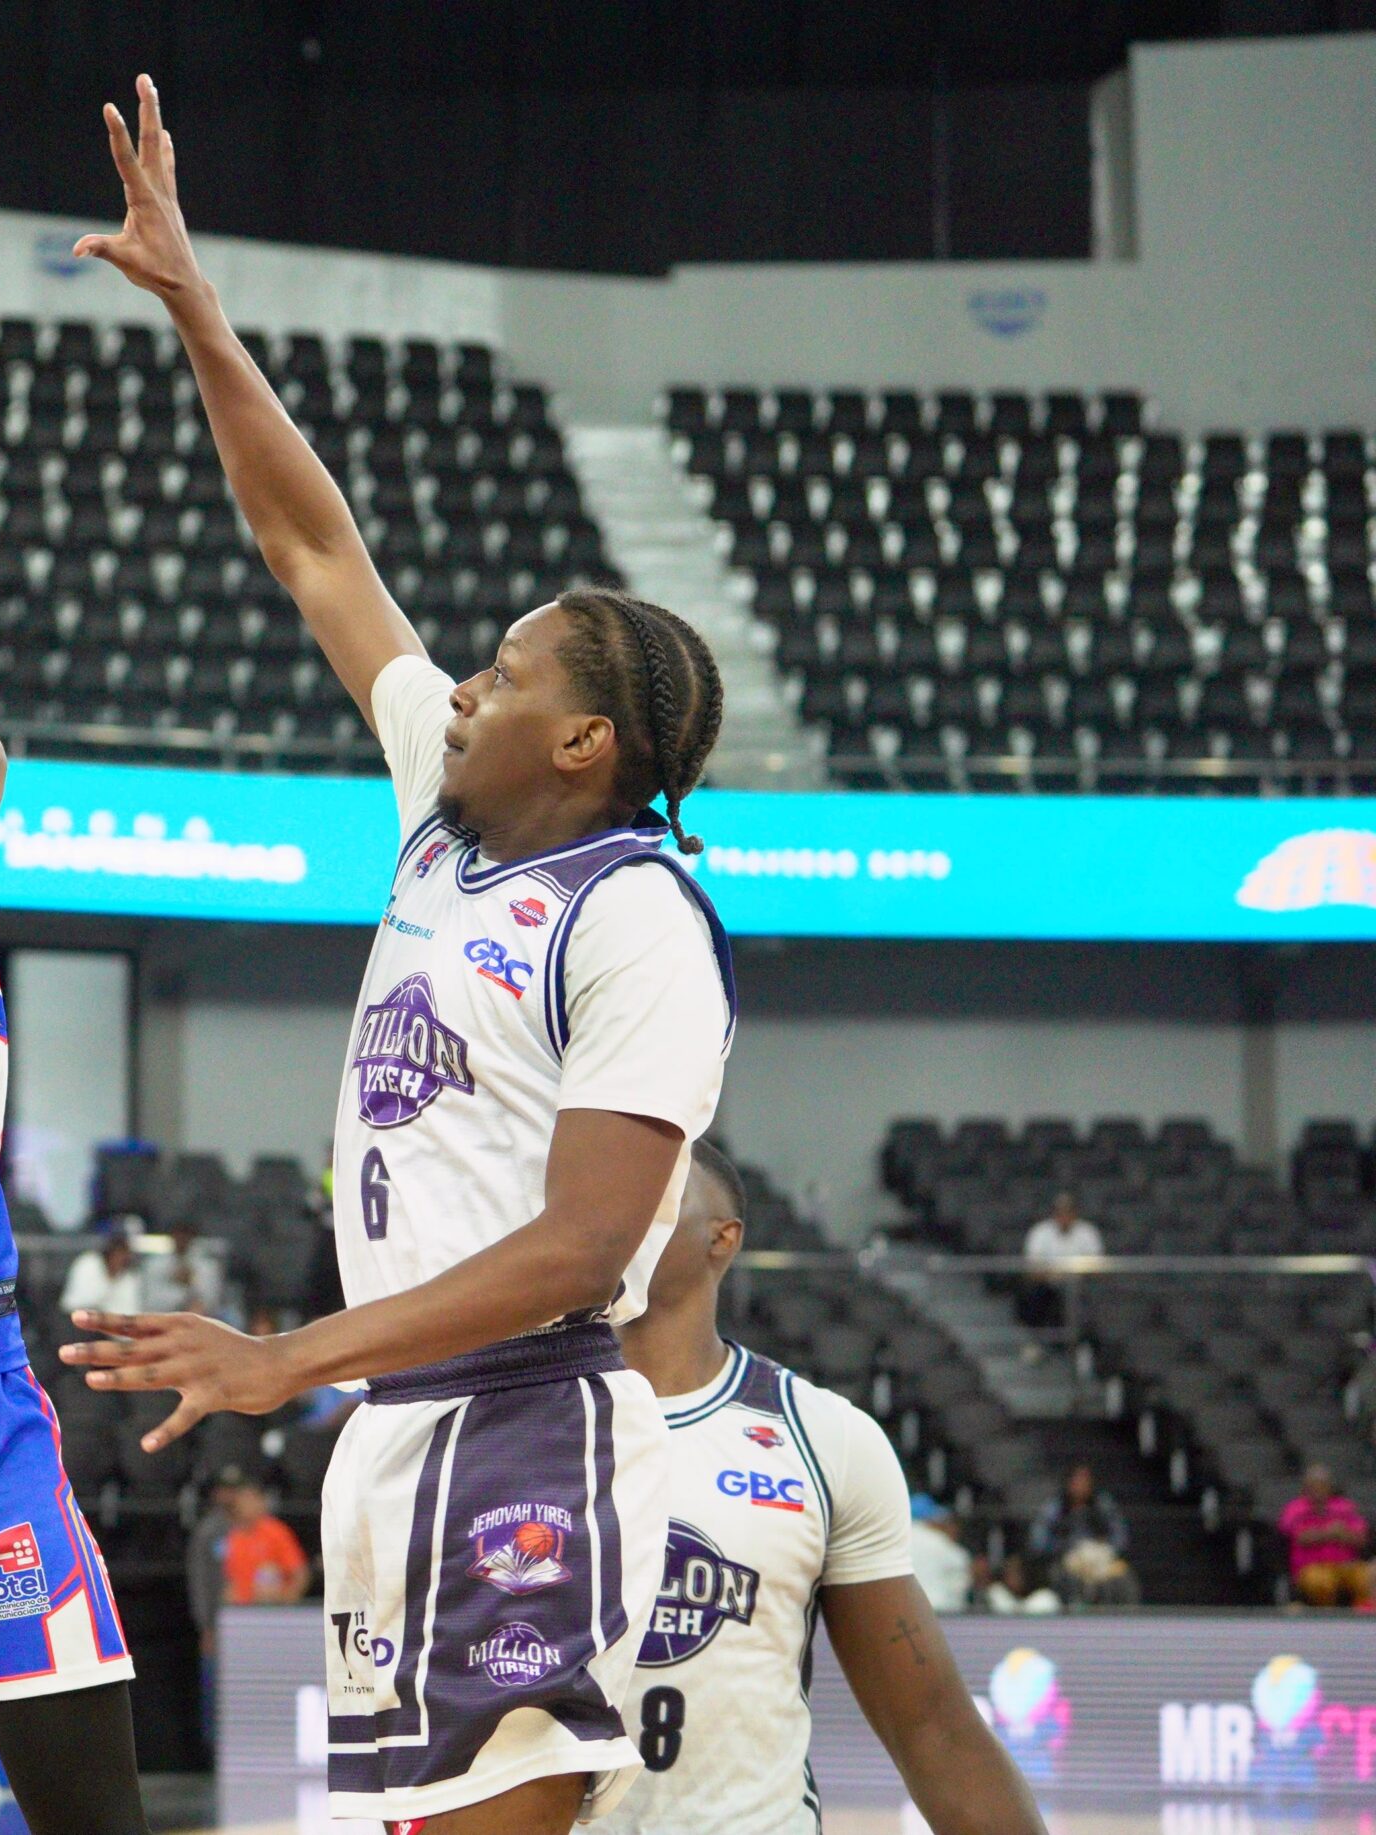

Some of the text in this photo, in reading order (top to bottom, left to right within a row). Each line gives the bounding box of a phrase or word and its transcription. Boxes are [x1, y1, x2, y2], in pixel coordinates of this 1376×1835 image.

[464, 937, 534, 992] GBC
[360, 1145, 391, 1241] 6
[716, 1469, 804, 1503] GBC
[468, 1503, 573, 1538] JEHOVAH YIREH
[37, 1596, 48, 1604] de
[657, 1552, 753, 1619] LON
[468, 1638, 562, 1668] MILLON
[489, 1660, 541, 1677] YIREH
[639, 1686, 686, 1773] 8
[1159, 1701, 1255, 1784] MR
